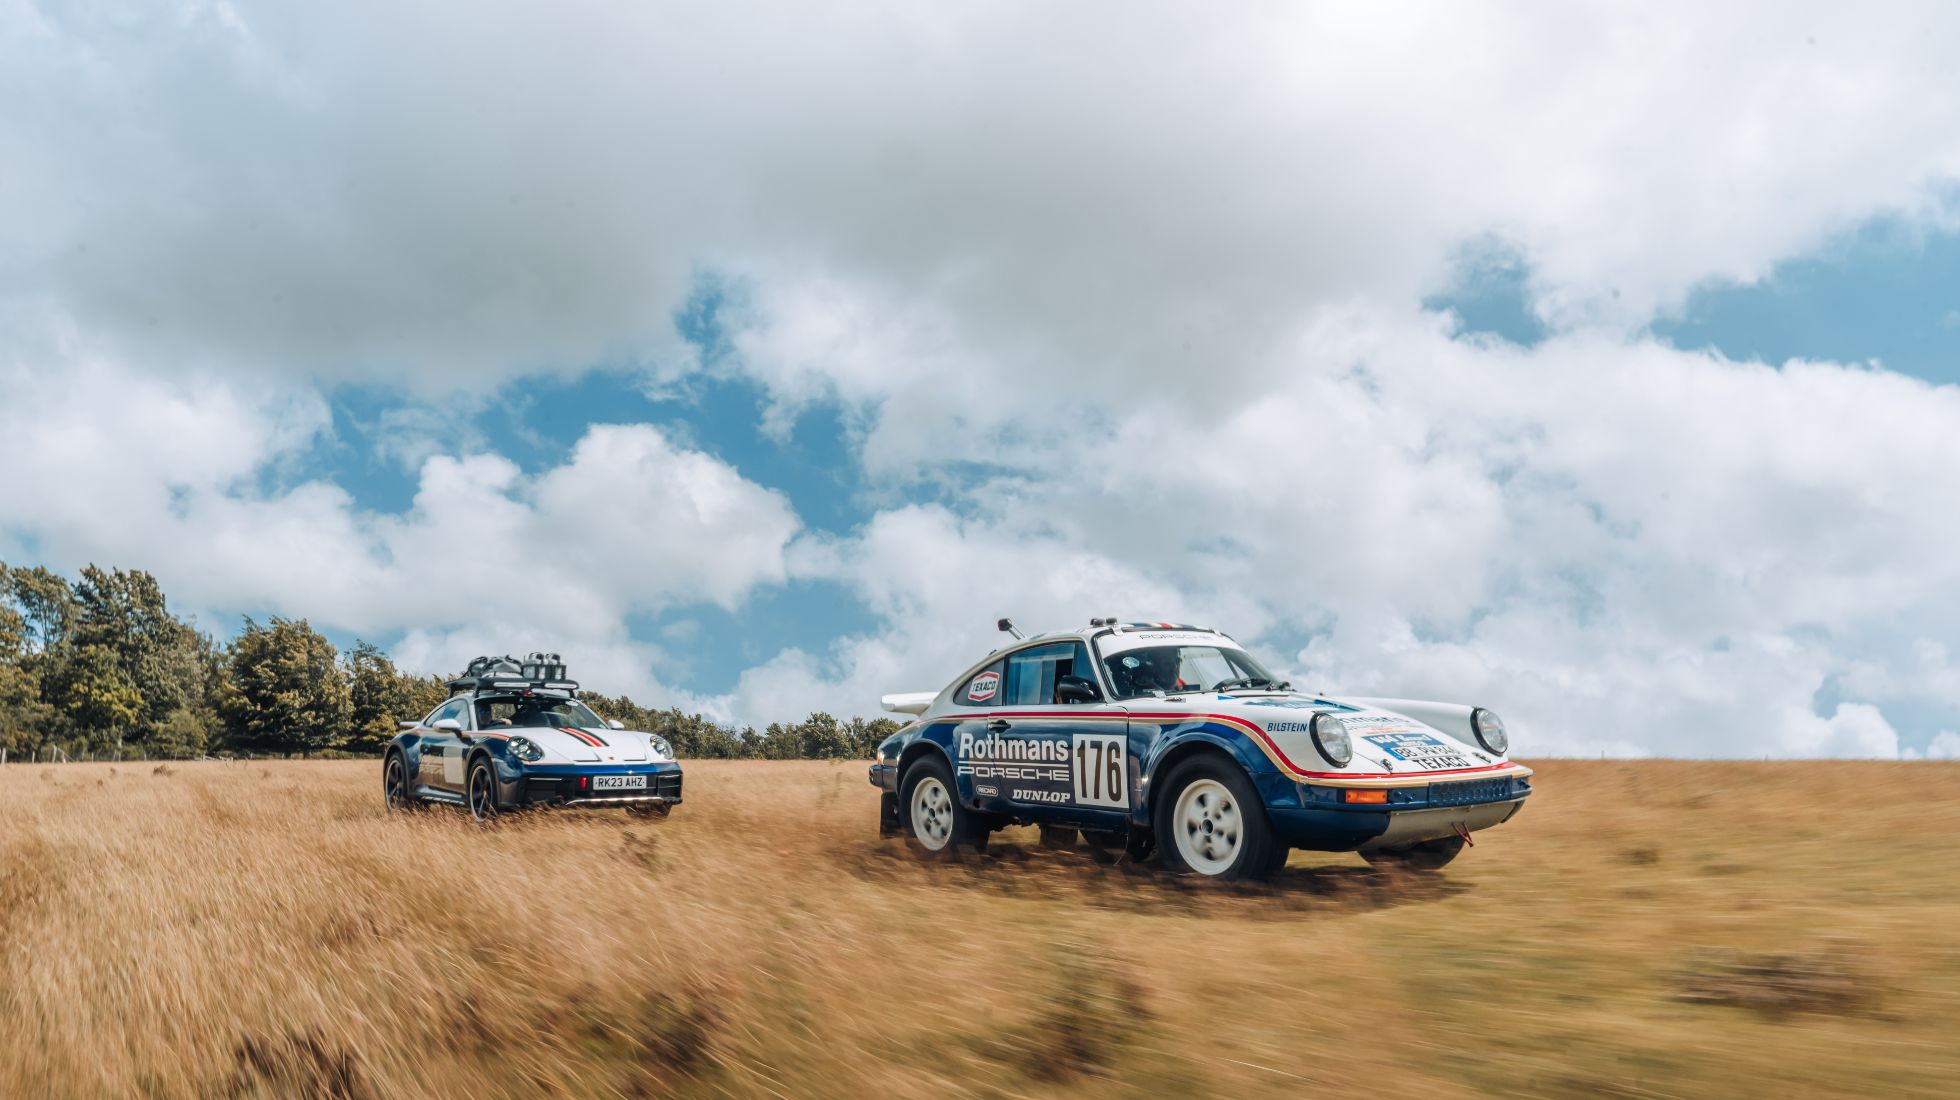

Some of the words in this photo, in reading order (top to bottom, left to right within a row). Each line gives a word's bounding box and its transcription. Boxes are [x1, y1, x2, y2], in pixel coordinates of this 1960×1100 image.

[973, 681, 997, 692] TEXACO
[1267, 722, 1307, 732] BILSTEIN
[958, 733, 1069, 761] Rothmans
[1412, 756, 1471, 770] TEXACO
[957, 766, 1070, 781] PORSCHE
[1077, 739, 1122, 802] 176
[598, 777, 623, 787] RK23
[625, 777, 643, 787] AHZ
[1012, 789, 1071, 803] DUNLOP
